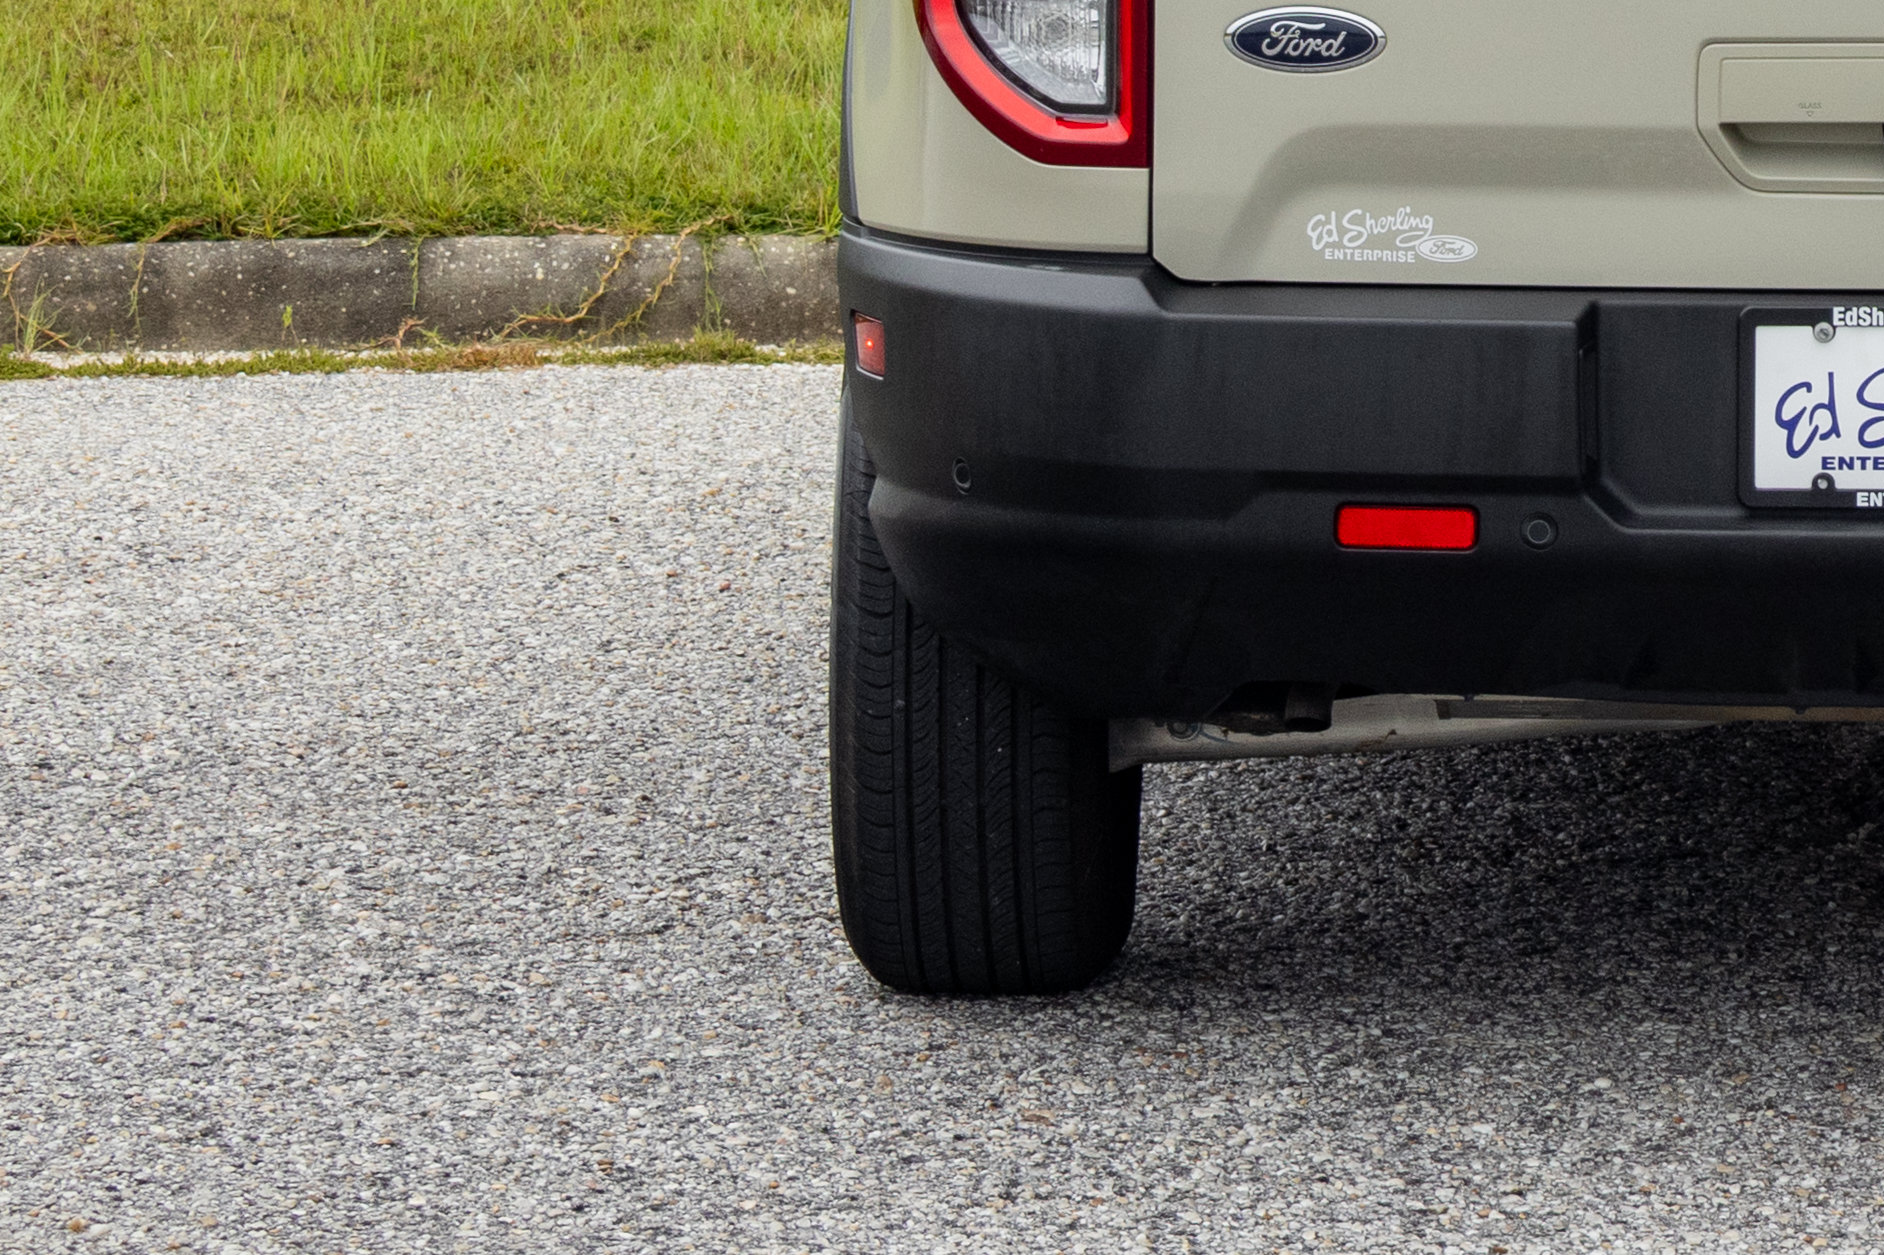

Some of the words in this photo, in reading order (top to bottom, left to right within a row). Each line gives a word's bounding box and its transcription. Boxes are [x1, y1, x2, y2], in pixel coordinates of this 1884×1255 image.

[1261, 20, 1347, 57] Ford
[1306, 211, 1339, 250] Ed
[1342, 205, 1434, 247] Sherling
[1324, 248, 1416, 263] ENTERPRISE
[1429, 240, 1465, 257] Ford
[1775, 371, 1842, 459] Ed
